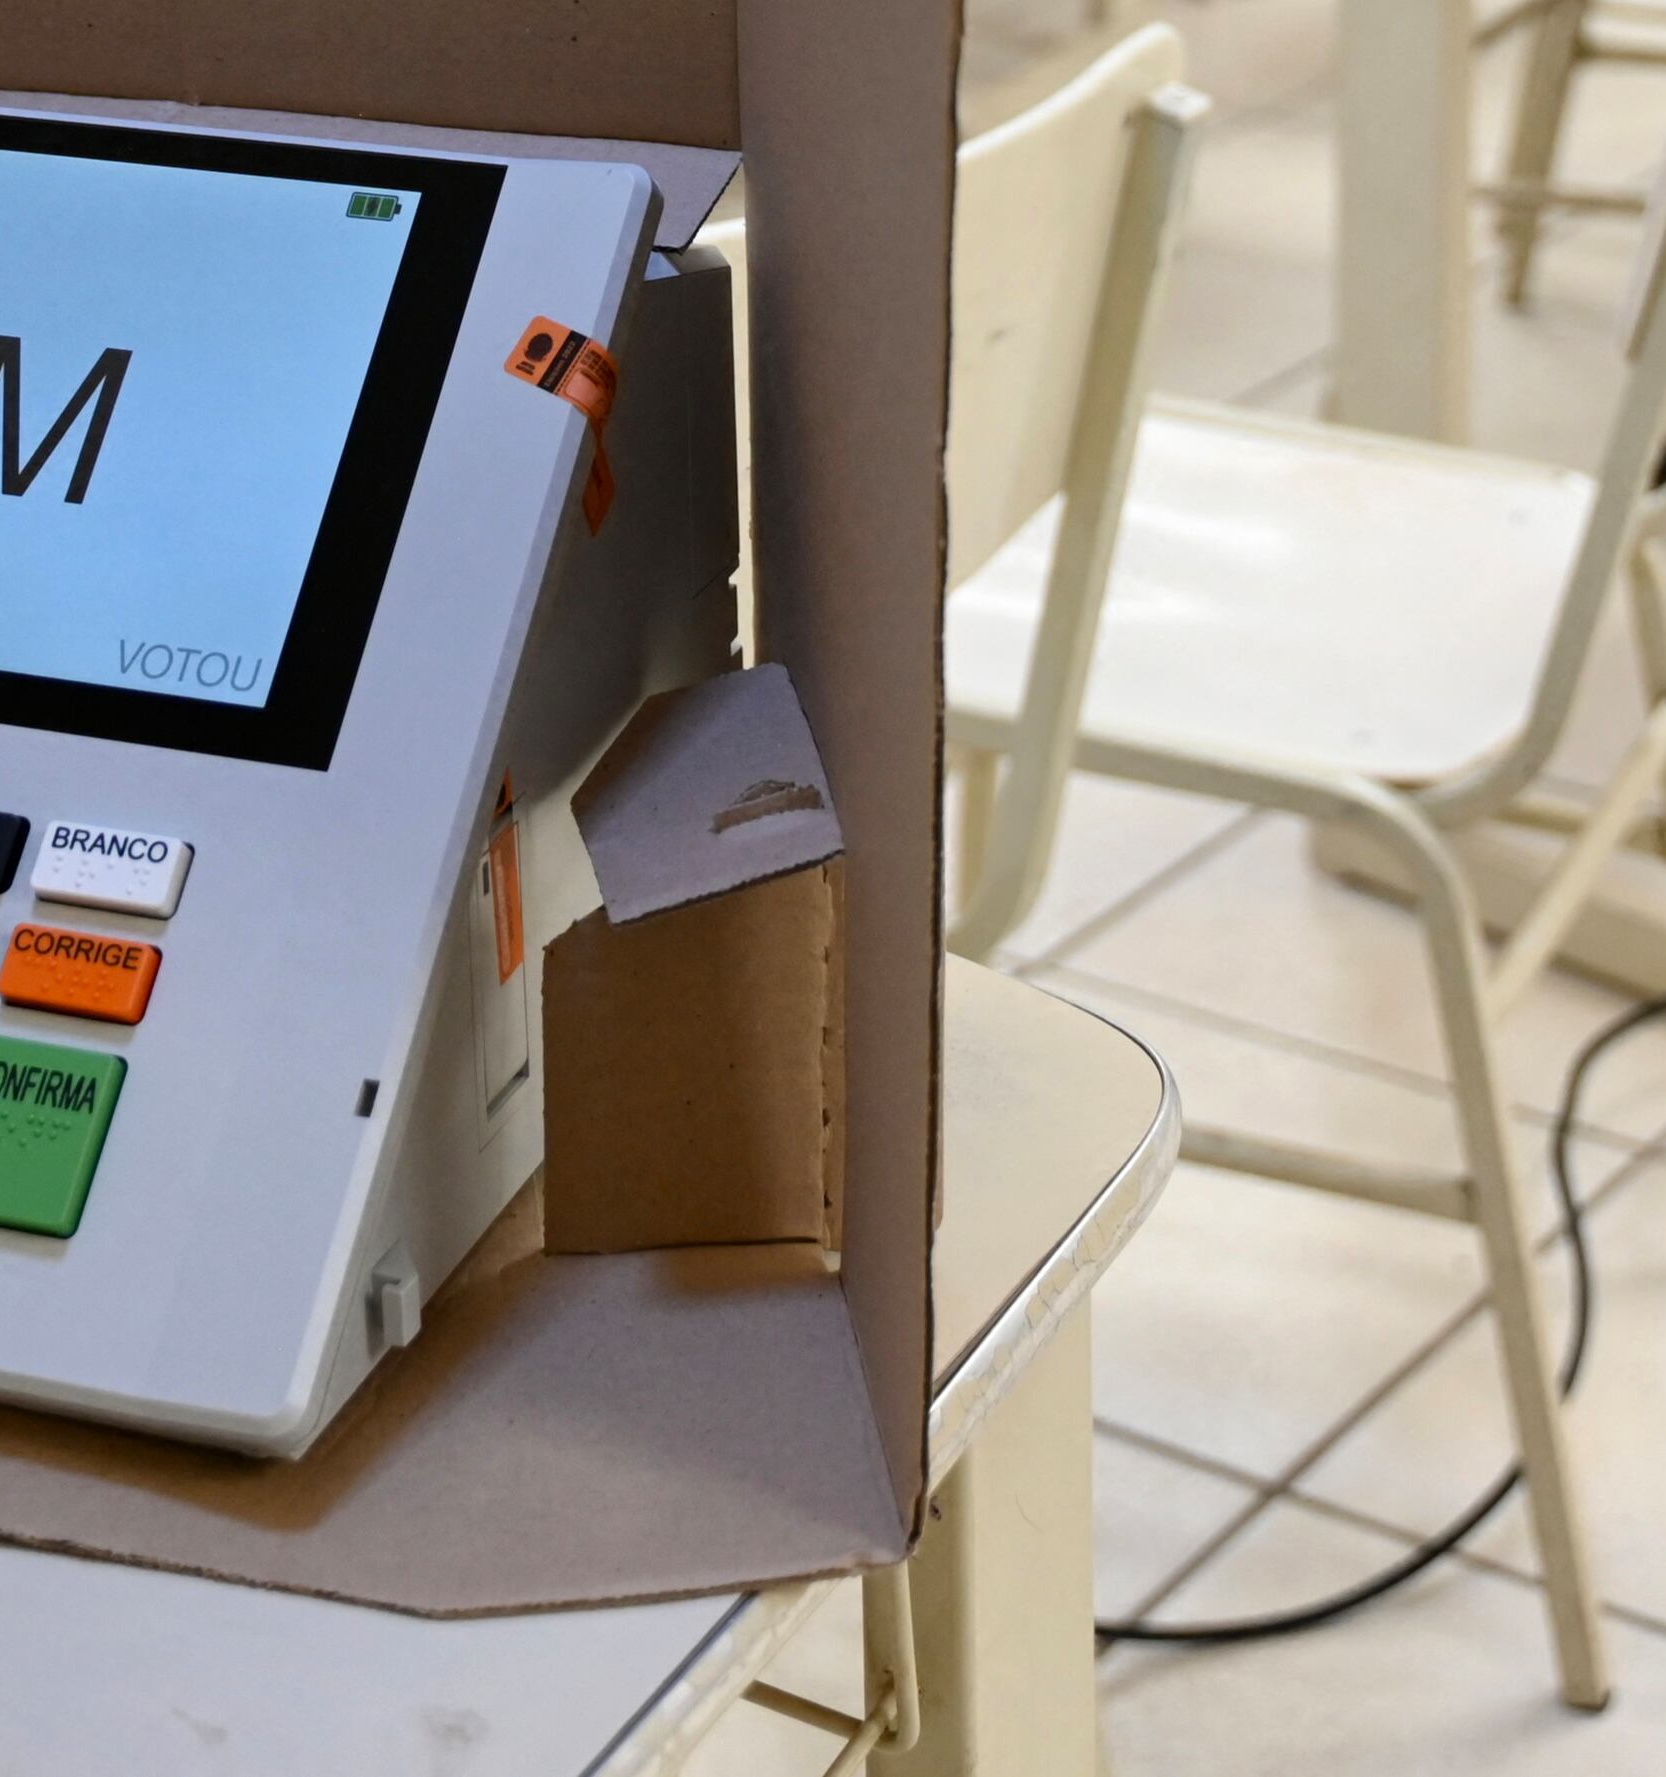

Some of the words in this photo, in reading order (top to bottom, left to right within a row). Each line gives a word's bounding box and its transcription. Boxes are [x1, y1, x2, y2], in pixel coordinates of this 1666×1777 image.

[118, 639, 262, 692] VOTOU
[50, 826, 169, 864] BRANCO
[13, 928, 144, 971] CORRIGE
